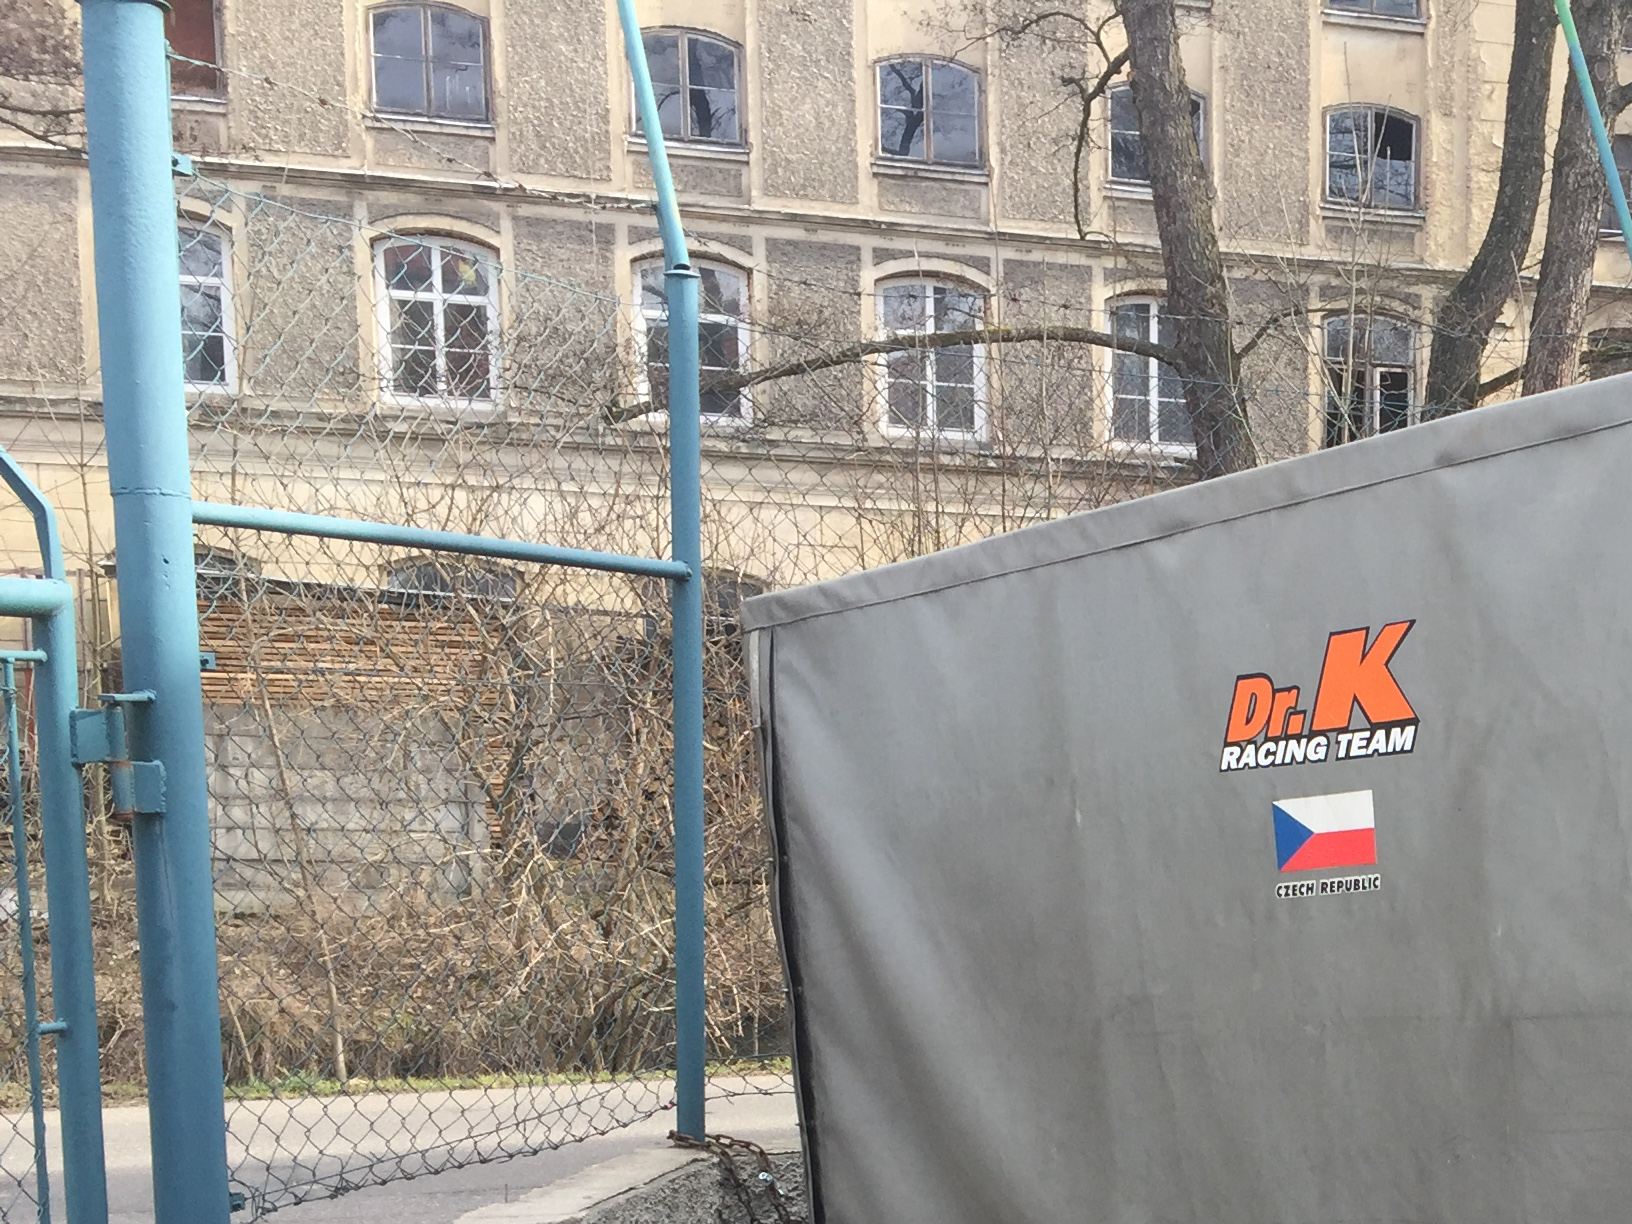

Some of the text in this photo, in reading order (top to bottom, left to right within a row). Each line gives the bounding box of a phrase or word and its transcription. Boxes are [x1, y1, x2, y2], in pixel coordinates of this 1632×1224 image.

[1220, 724, 1418, 772] RACING TEAM
[1276, 875, 1380, 898] CZECH REPUBLIC
